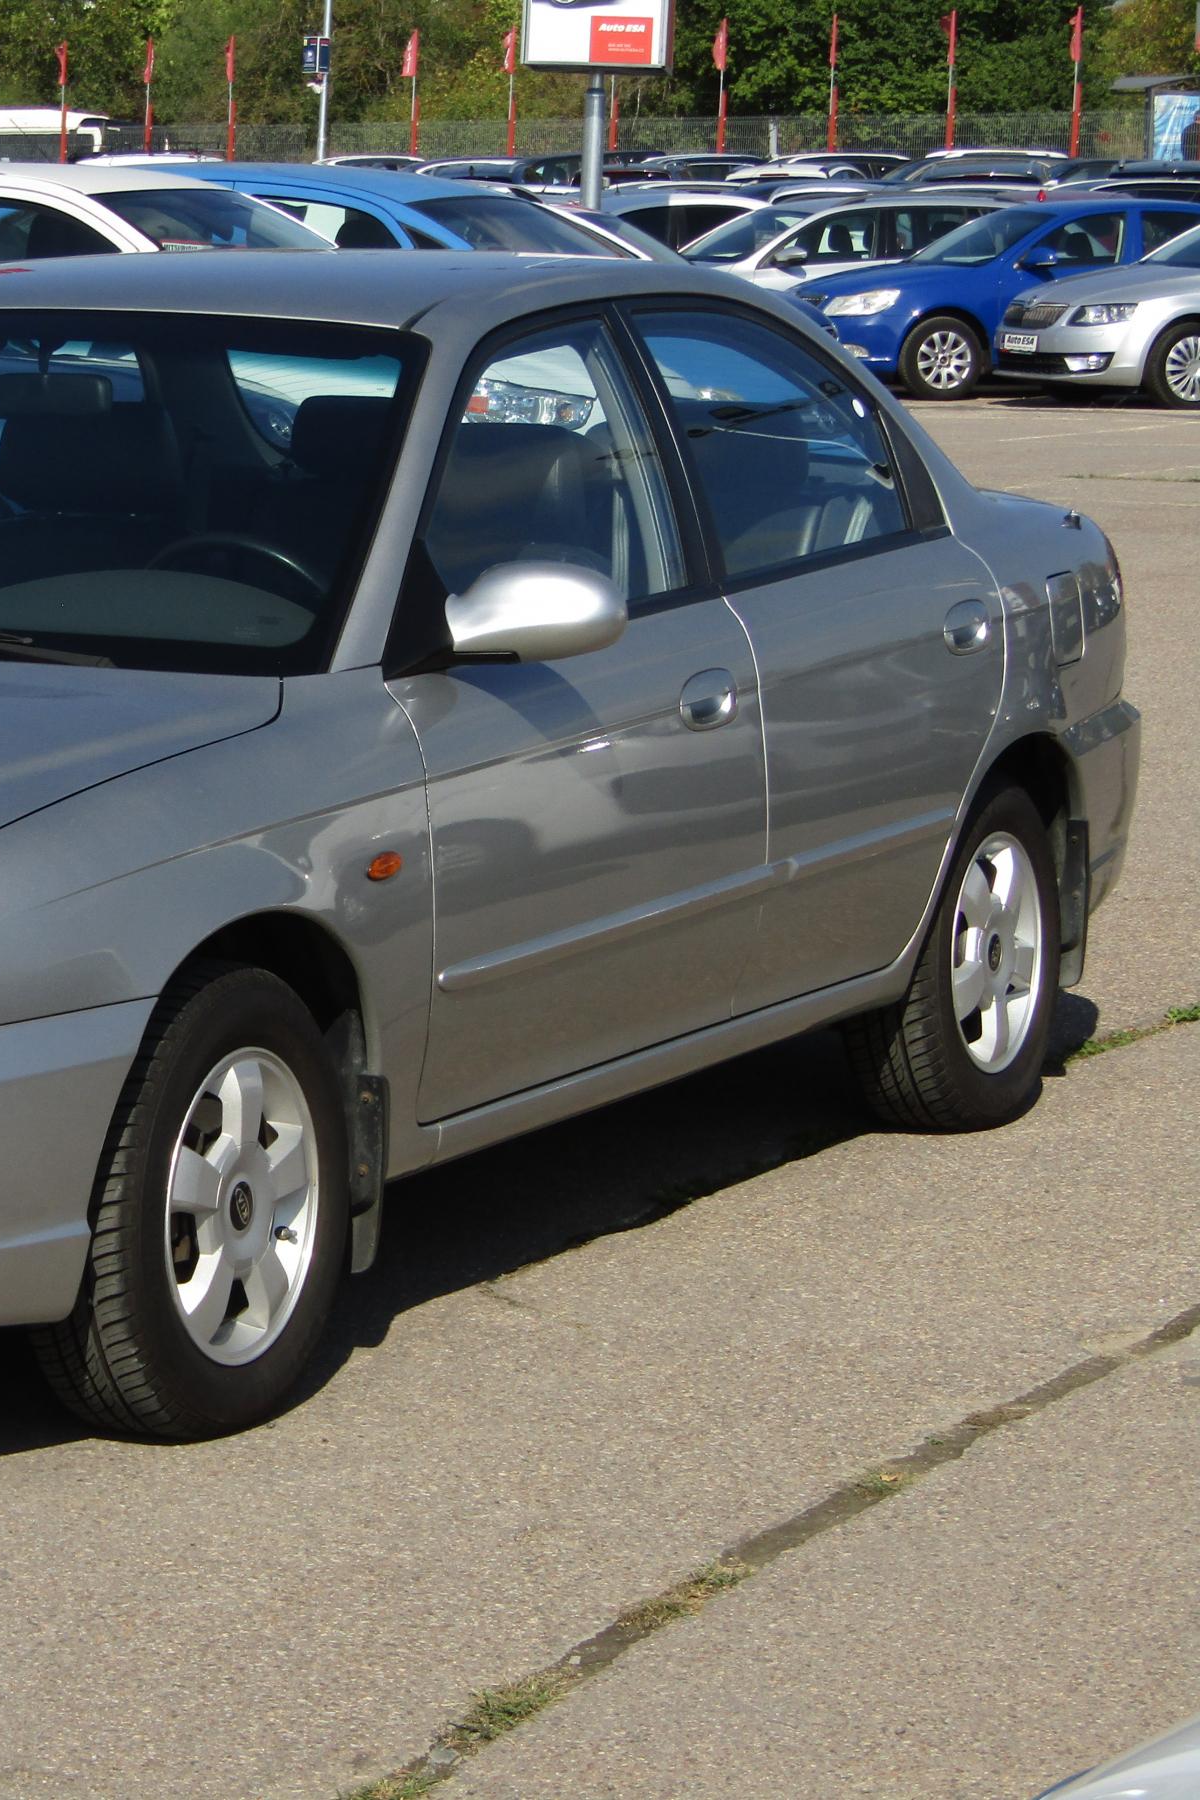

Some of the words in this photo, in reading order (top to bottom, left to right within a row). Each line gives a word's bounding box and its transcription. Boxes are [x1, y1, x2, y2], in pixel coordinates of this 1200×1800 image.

[598, 24, 625, 32] Auto
[625, 24, 646, 33] ESA
[1007, 336, 1021, 345] Auto
[1022, 337, 1035, 345] ESA
